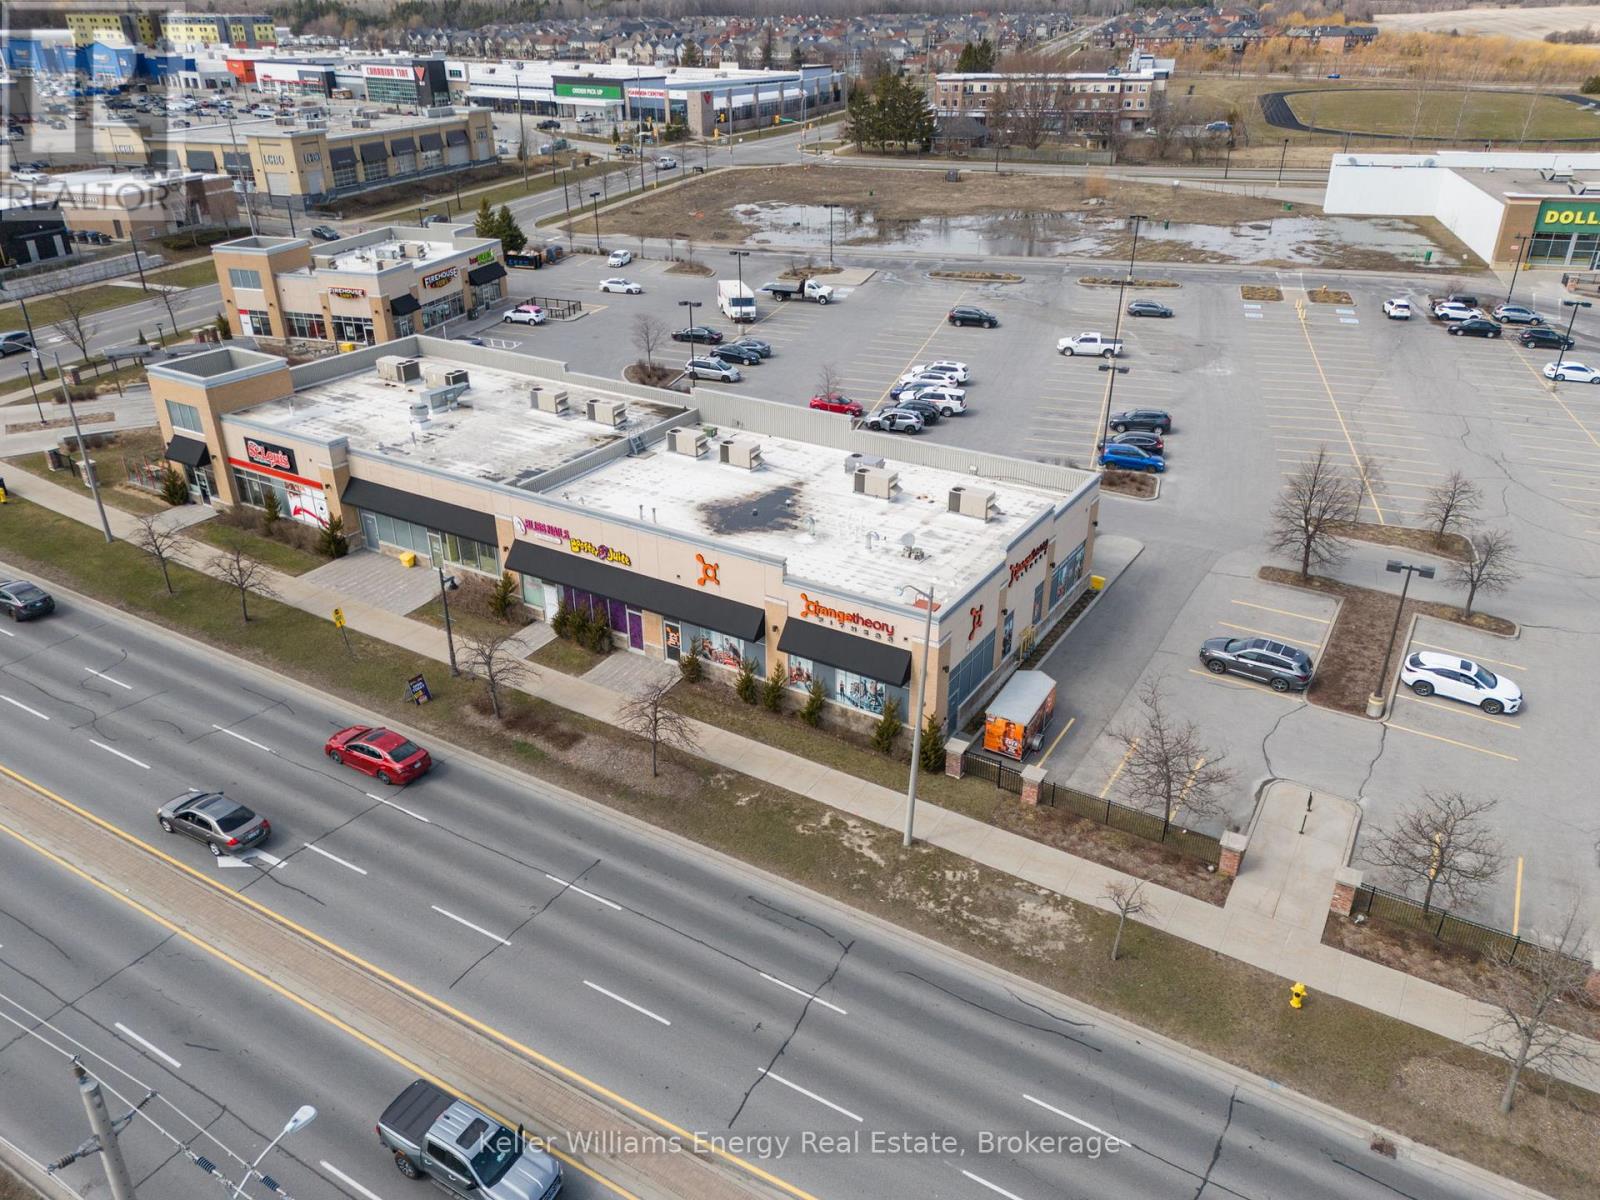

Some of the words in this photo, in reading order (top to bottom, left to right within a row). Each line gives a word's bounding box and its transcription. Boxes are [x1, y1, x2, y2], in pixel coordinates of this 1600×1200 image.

[1544, 210, 1600, 225] DOLL
[424, 267, 459, 288] FIREHOUSE
[607, 548, 632, 566] Juice
